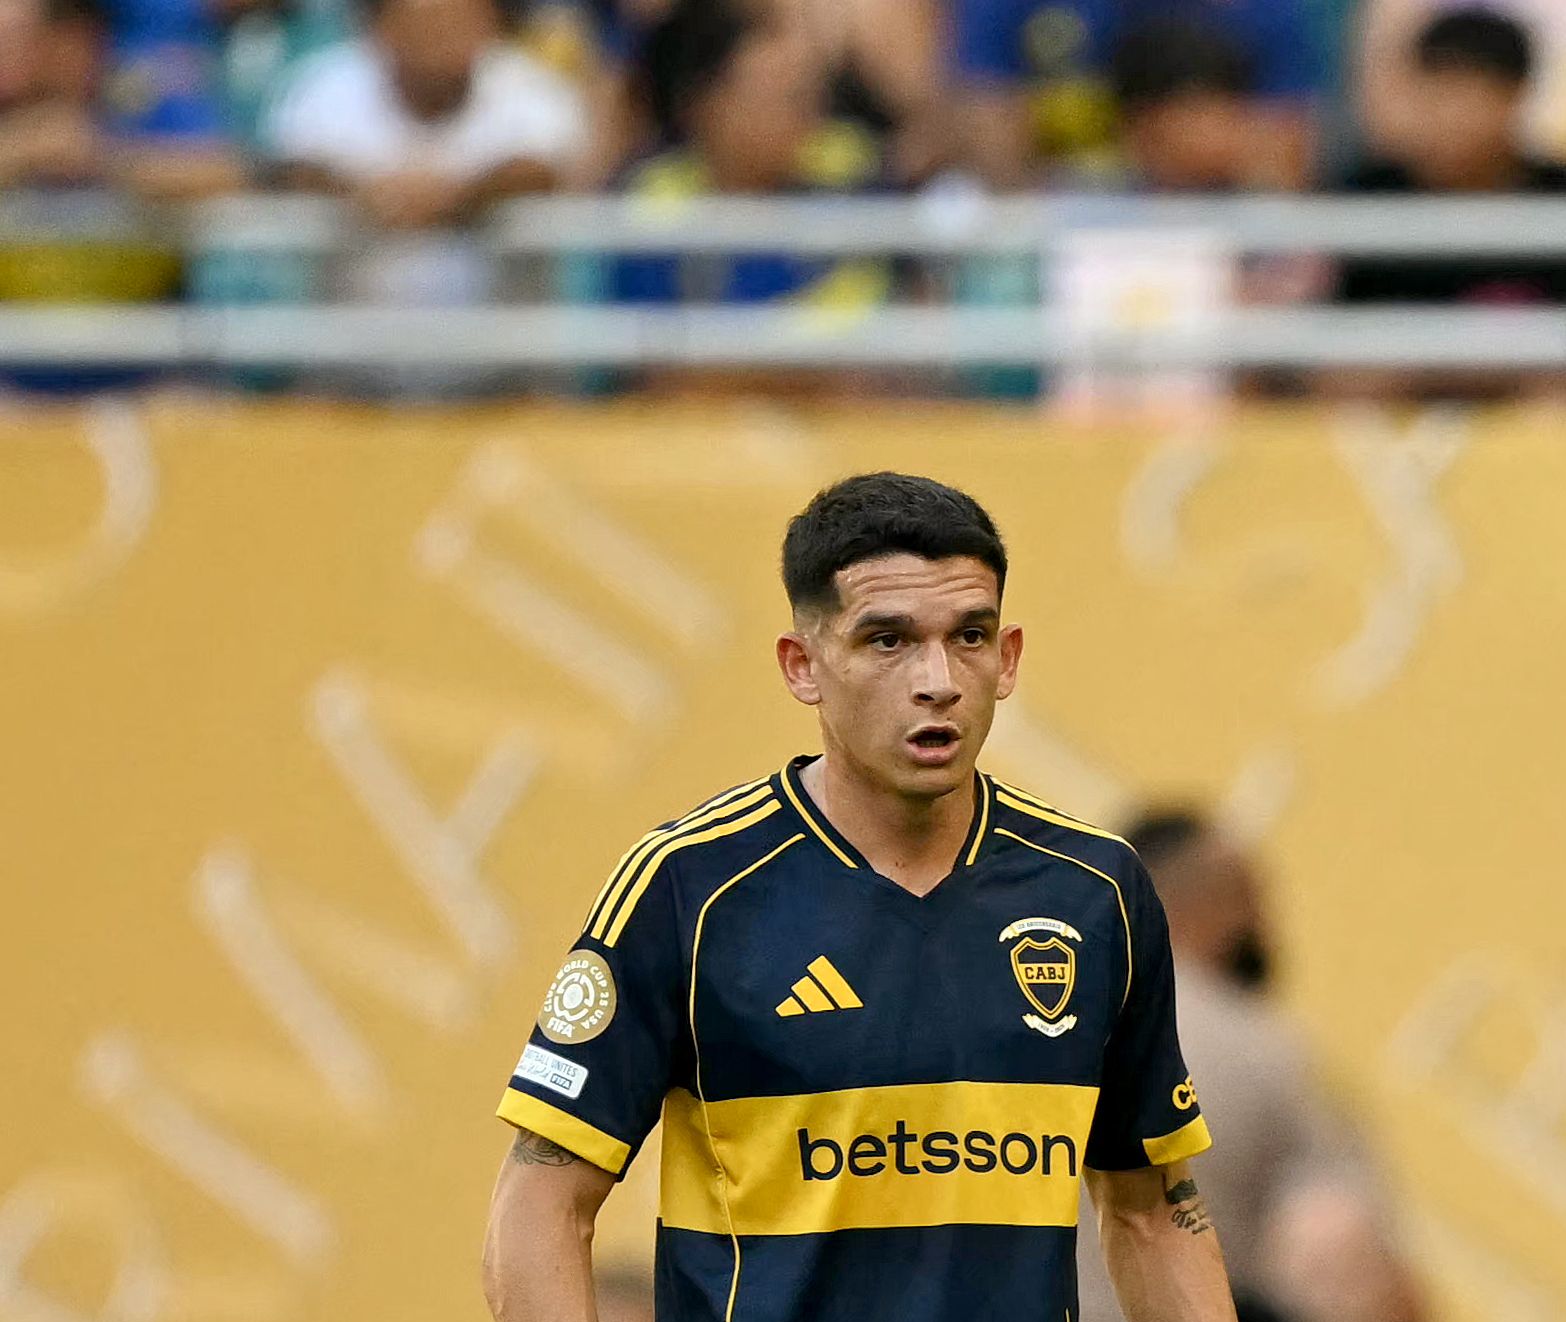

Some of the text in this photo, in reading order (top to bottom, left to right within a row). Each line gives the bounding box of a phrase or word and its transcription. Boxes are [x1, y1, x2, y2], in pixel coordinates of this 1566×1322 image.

[556, 960, 589, 980] WORLD
[590, 966, 608, 988] CUP
[1024, 966, 1066, 981] CABJ
[546, 1017, 573, 1038] FIFA
[581, 1010, 604, 1030] USA
[797, 1119, 1077, 1181] betsson
